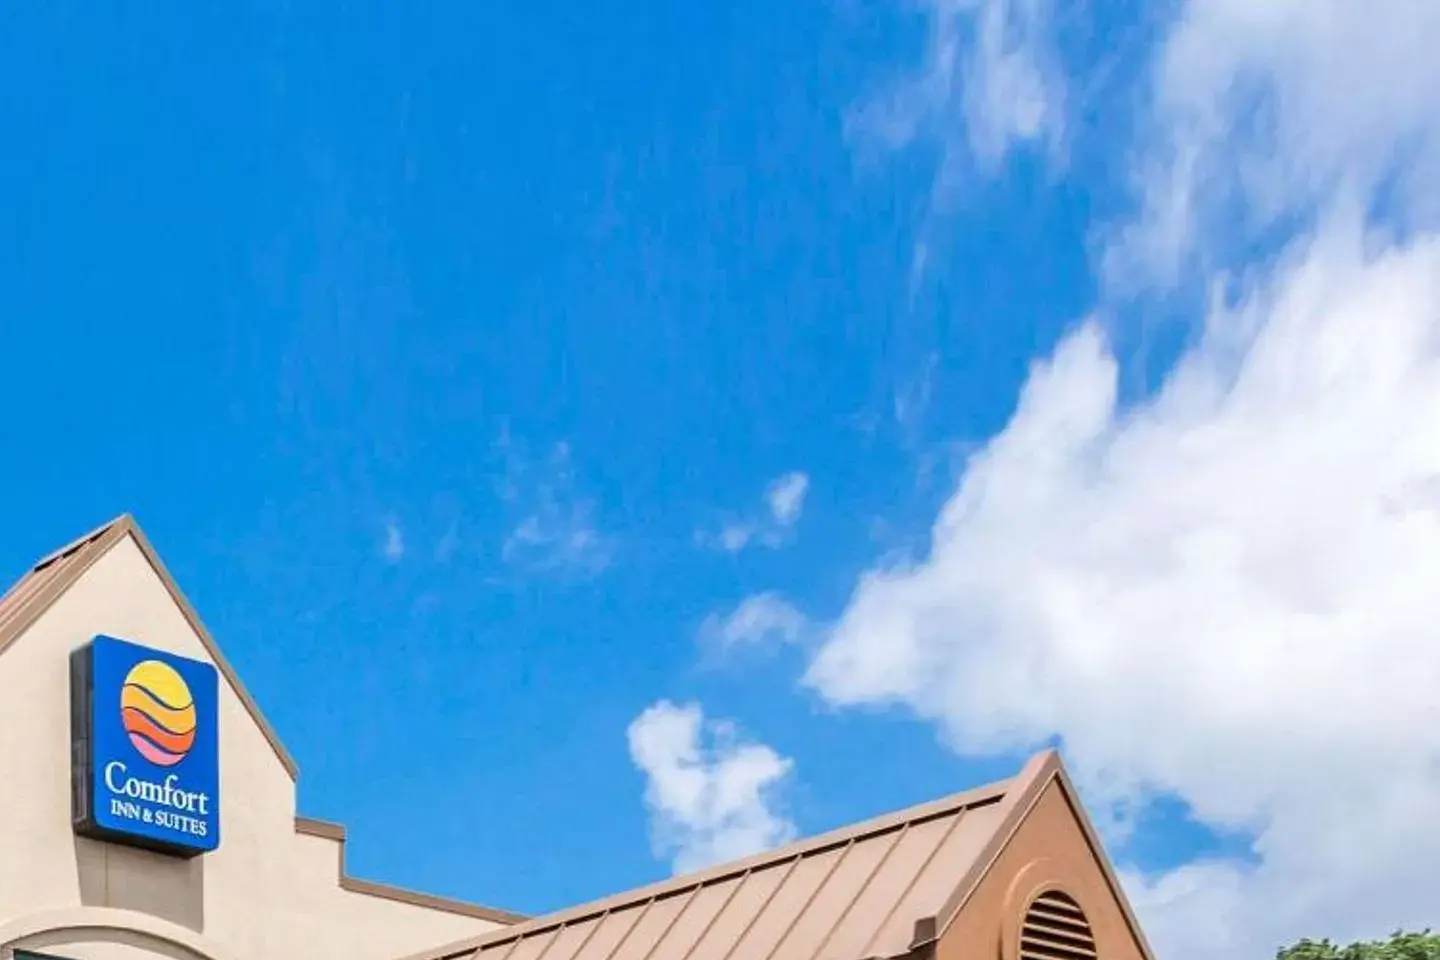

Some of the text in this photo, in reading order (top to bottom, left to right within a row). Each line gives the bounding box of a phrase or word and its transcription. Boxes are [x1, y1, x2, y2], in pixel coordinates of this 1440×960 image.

[105, 761, 209, 815] Comfort
[111, 798, 207, 836] INN & SUITES
